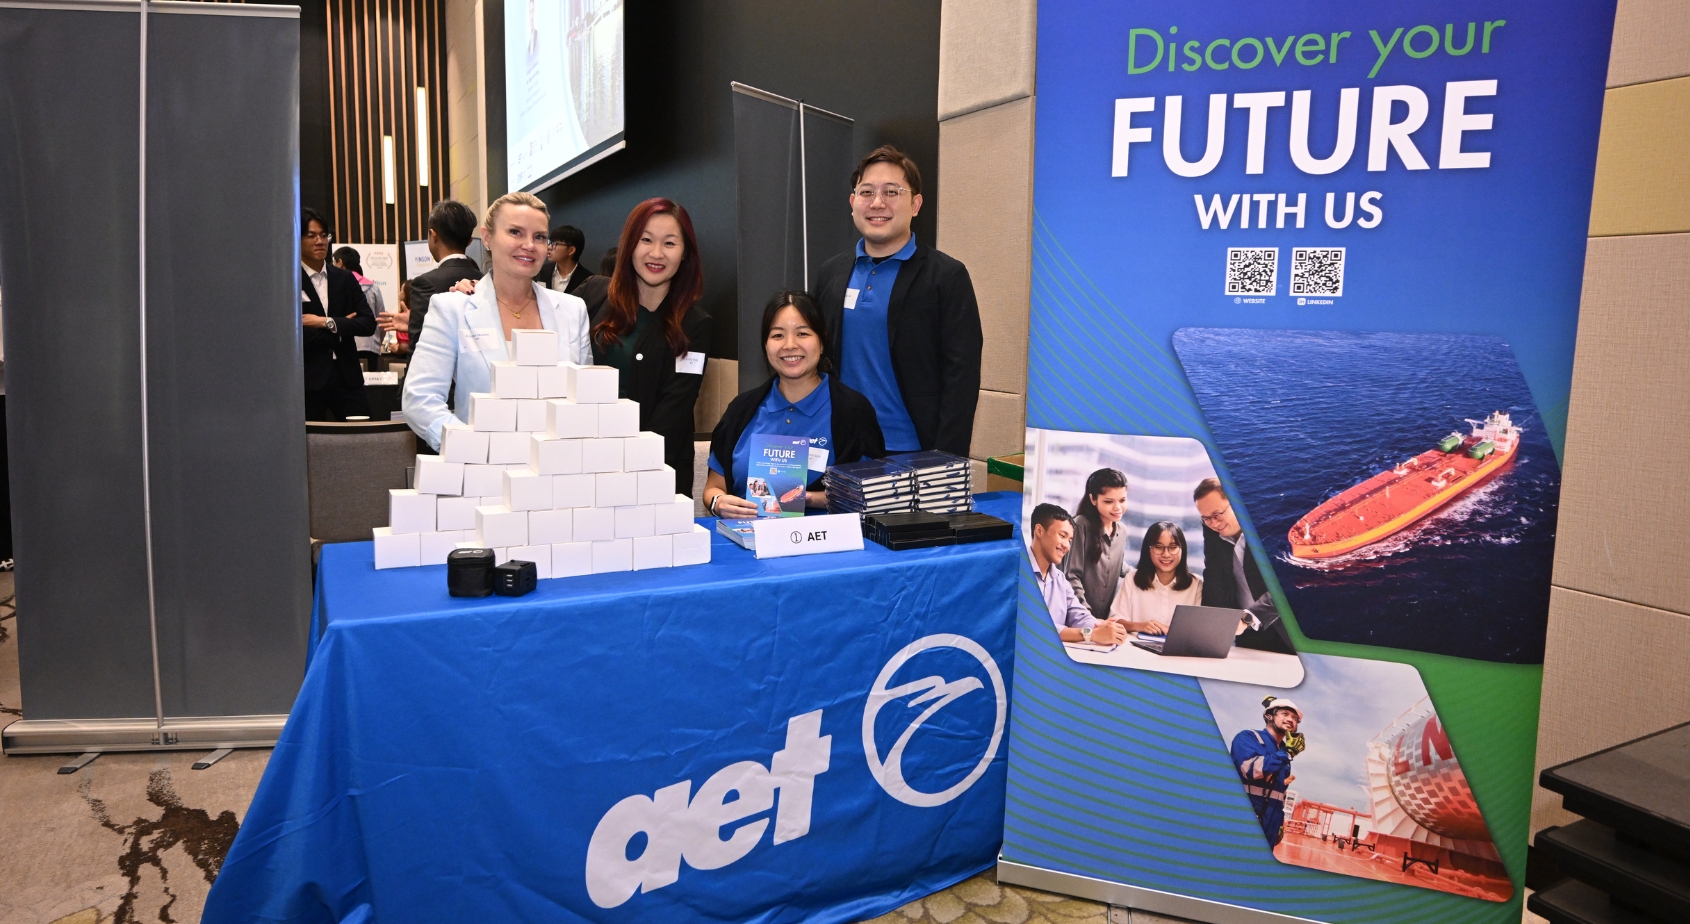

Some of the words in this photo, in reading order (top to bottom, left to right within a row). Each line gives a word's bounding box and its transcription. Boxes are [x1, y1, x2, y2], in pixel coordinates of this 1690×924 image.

[1127, 25, 1352, 75] Discover
[1367, 19, 1507, 78] your
[1111, 79, 1498, 178] FUTURE
[1193, 193, 1307, 230] WITH
[1324, 190, 1383, 229] US
[764, 449, 796, 459] FUTURE
[807, 530, 828, 542] AET
[585, 708, 832, 909] aet
